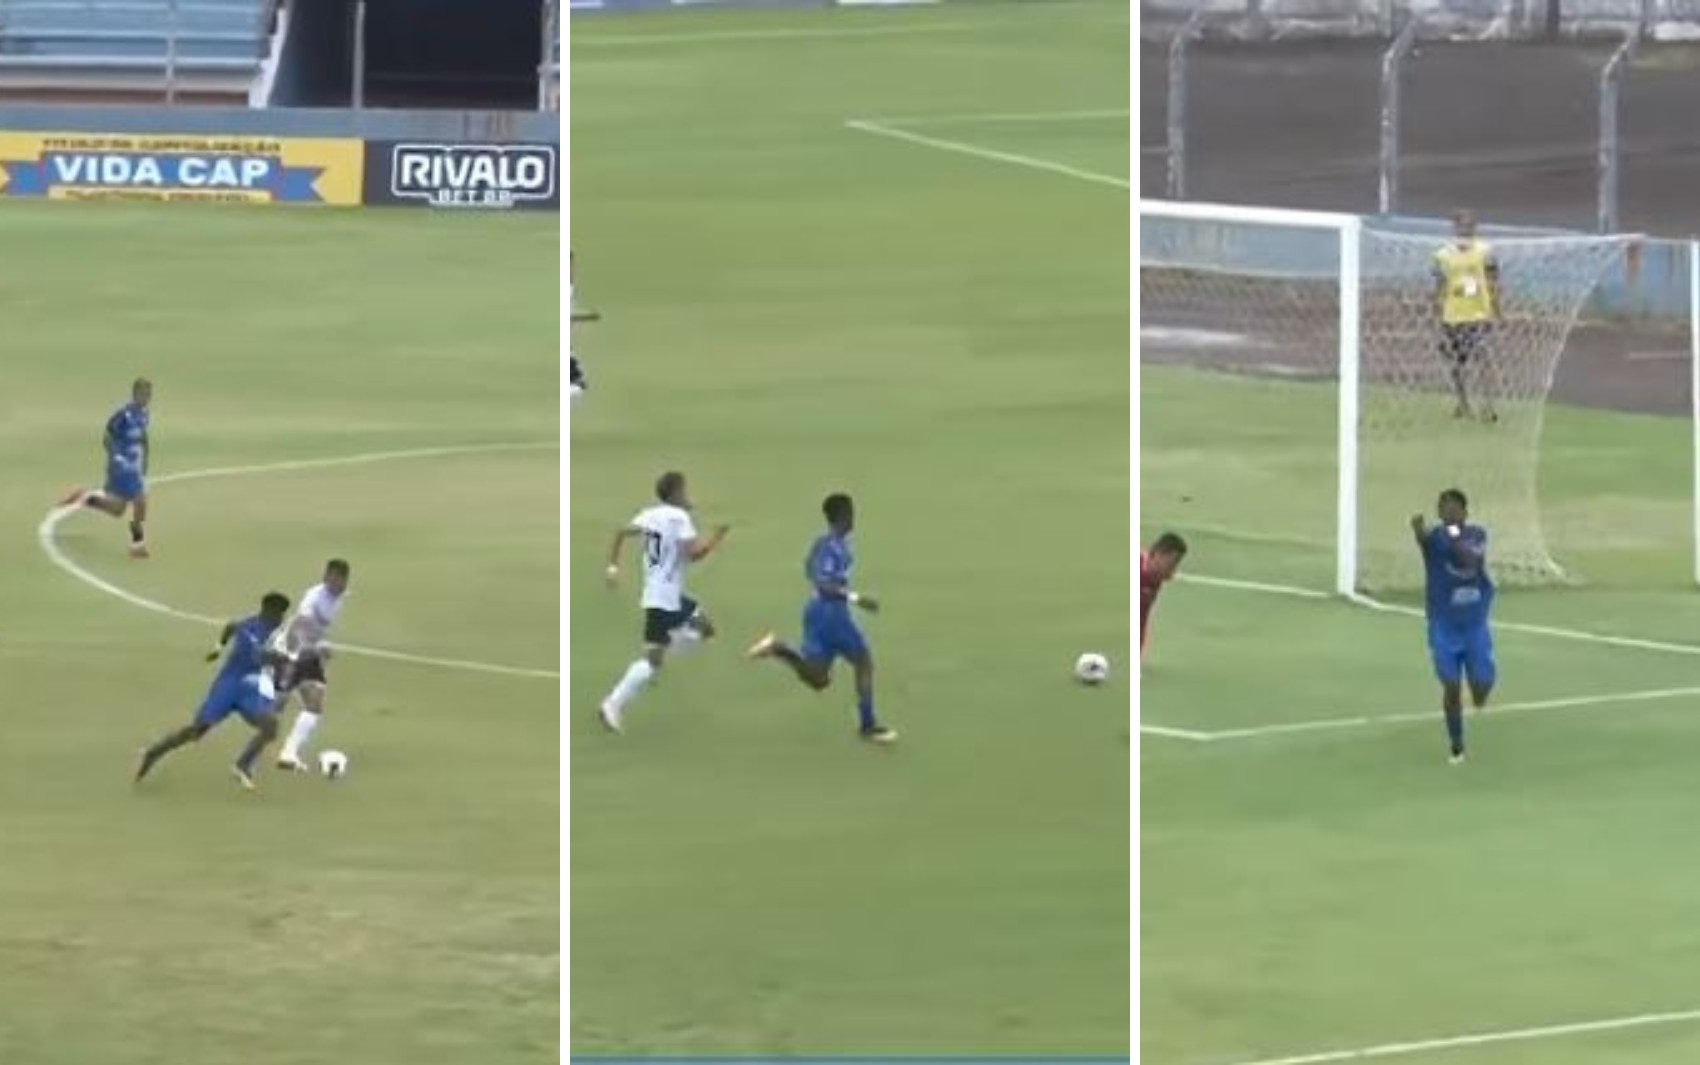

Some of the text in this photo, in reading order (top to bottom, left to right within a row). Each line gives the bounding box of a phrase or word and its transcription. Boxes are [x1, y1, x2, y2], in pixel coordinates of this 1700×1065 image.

[53, 155, 270, 187] VIDA CAP
[400, 153, 545, 189] RIVALO
